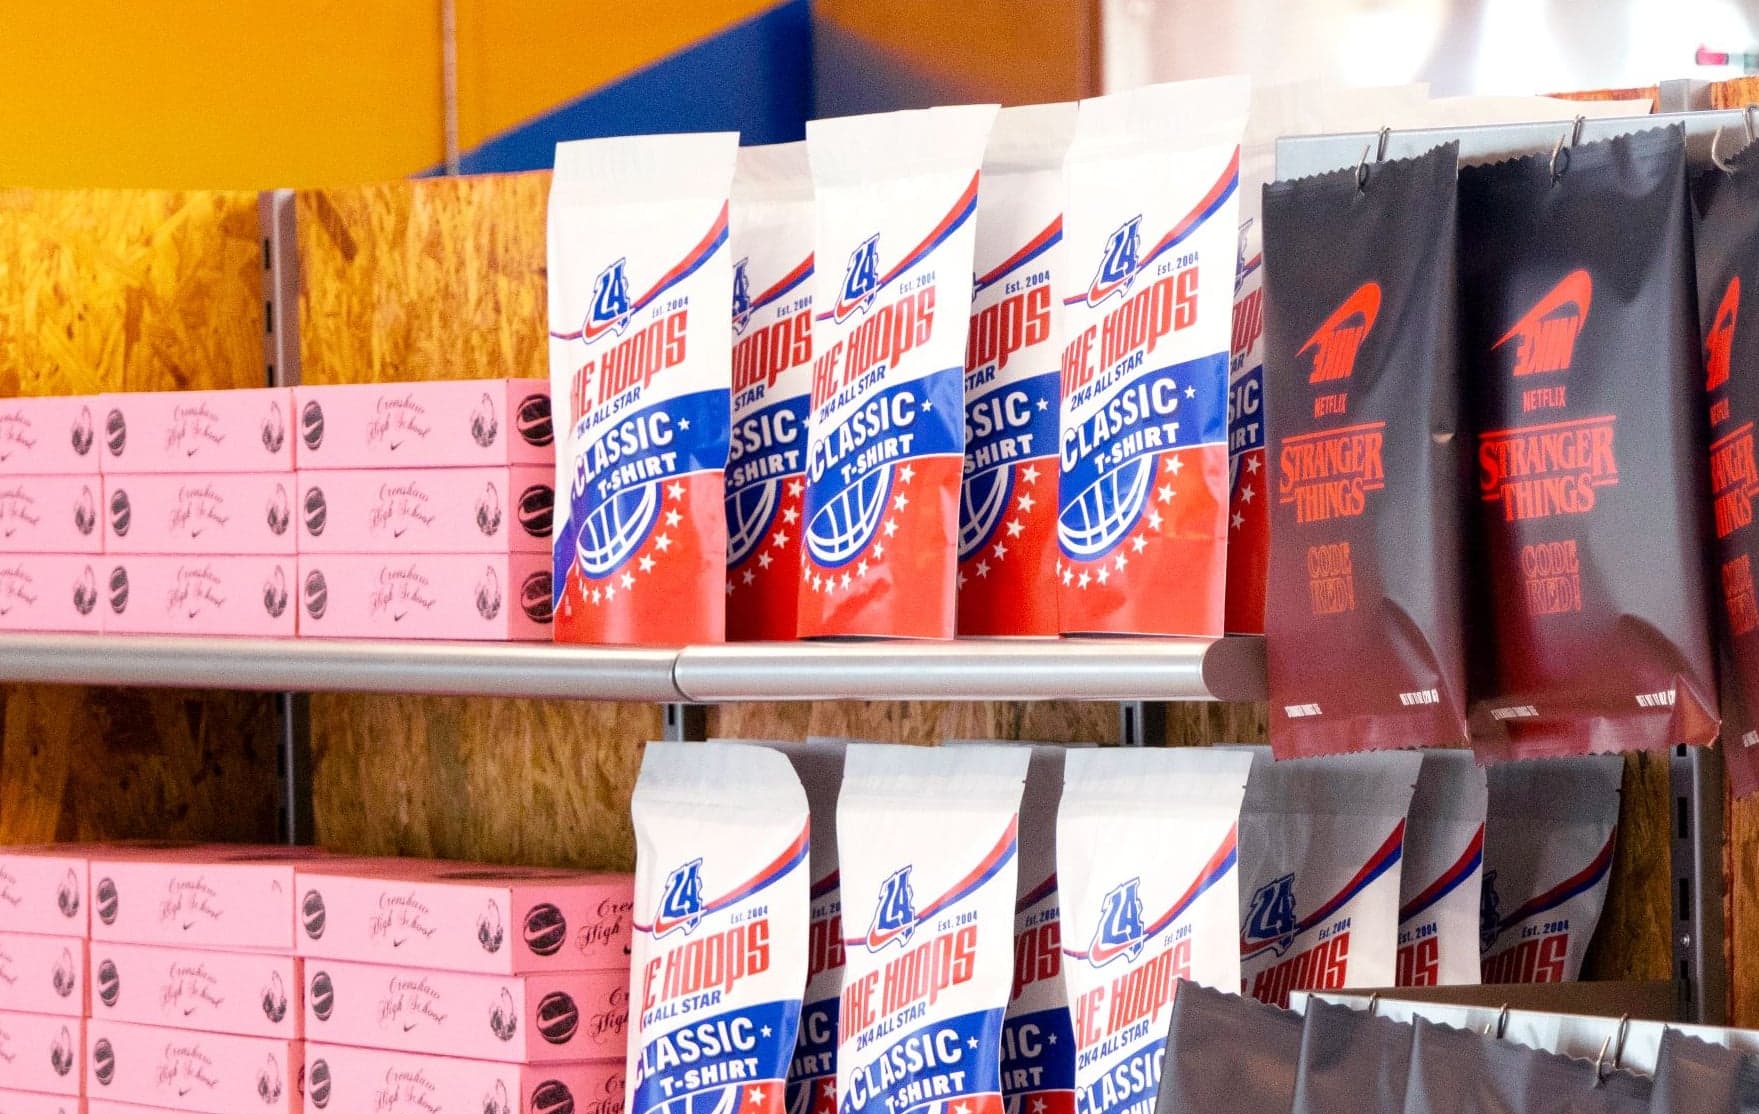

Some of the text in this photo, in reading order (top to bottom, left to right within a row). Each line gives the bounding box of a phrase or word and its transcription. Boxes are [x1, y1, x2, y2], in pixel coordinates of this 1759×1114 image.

[1006, 270, 1050, 295] Est. 2004
[1177, 251, 1199, 270] 2004
[1100, 266, 1199, 373] HOOPS
[734, 384, 765, 412] STAR
[837, 385, 857, 408] ALL
[858, 365, 886, 393] STAR
[1070, 350, 1144, 412] 2K4 ALL STAR
[1523, 385, 1565, 413] NETFLIX
[593, 386, 641, 427] ALL STAR
[1061, 378, 1178, 473] CLASSIC
[1313, 391, 1347, 419] NETFLIX
[573, 412, 674, 499] CLASSIC
[811, 391, 915, 484] CLASSIC
[841, 434, 914, 484] T-SHIRT
[1094, 423, 1179, 474] T-SHIRT
[1479, 423, 1618, 490] STRANGER
[598, 452, 677, 498] T-SHIRT
[1280, 430, 1384, 493] STRANGER
[1295, 480, 1366, 522] THINGS
[1500, 473, 1595, 522] THINGS
[1307, 543, 1351, 576] CODE
[1521, 540, 1579, 576] CODE
[596, 897, 634, 917] Cren
[956, 910, 978, 928] 2004
[881, 924, 977, 1024] HOOPS
[655, 990, 722, 1021] ALL STAR
[857, 1001, 926, 1052] 2K4 ALL STAR
[634, 1016, 756, 1090] CLASSIC
[1078, 1020, 1149, 1072] 2K4 ALL STAR
[660, 1057, 758, 1097] T-SHIRT
[850, 1028, 961, 1112] CLASSIC
